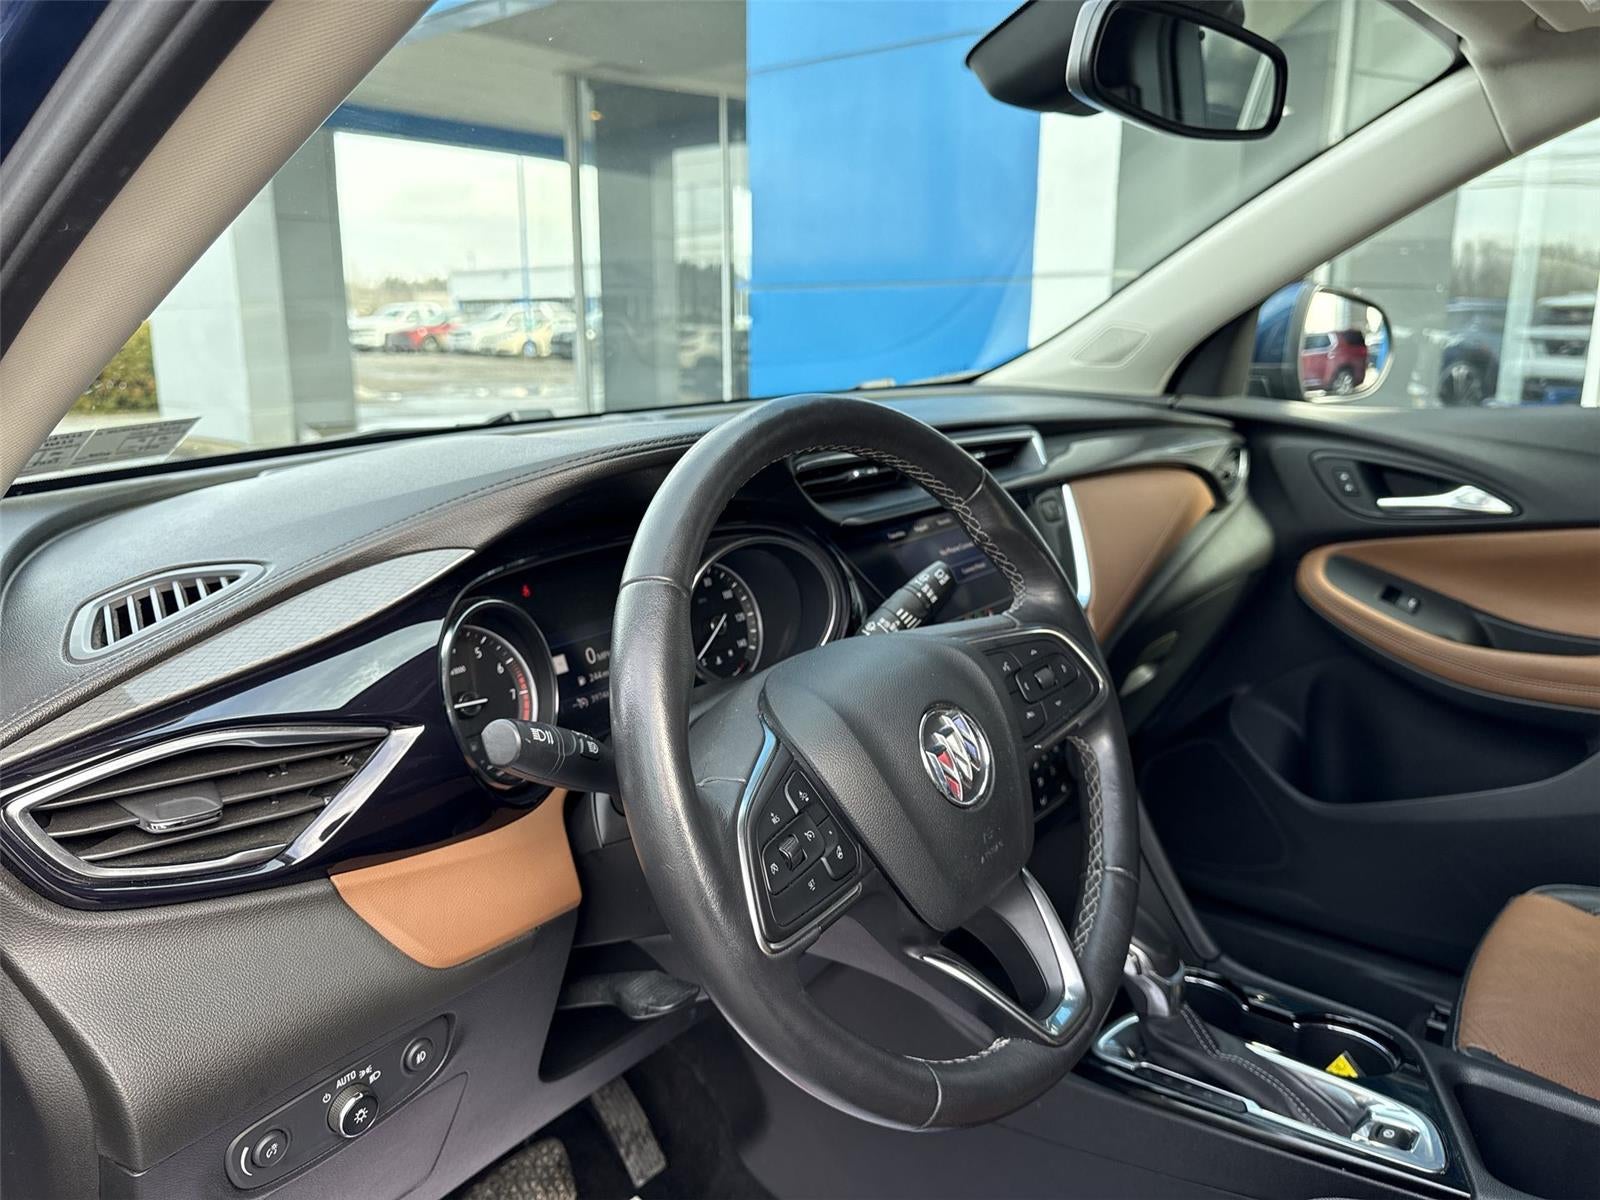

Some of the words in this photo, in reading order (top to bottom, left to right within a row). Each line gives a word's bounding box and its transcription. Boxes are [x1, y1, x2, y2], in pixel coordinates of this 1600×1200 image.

[474, 645, 483, 659] 5
[585, 647, 597, 665] 0
[496, 663, 505, 675] 6
[509, 688, 516, 700] 7
[336, 1070, 357, 1089] AUTO
